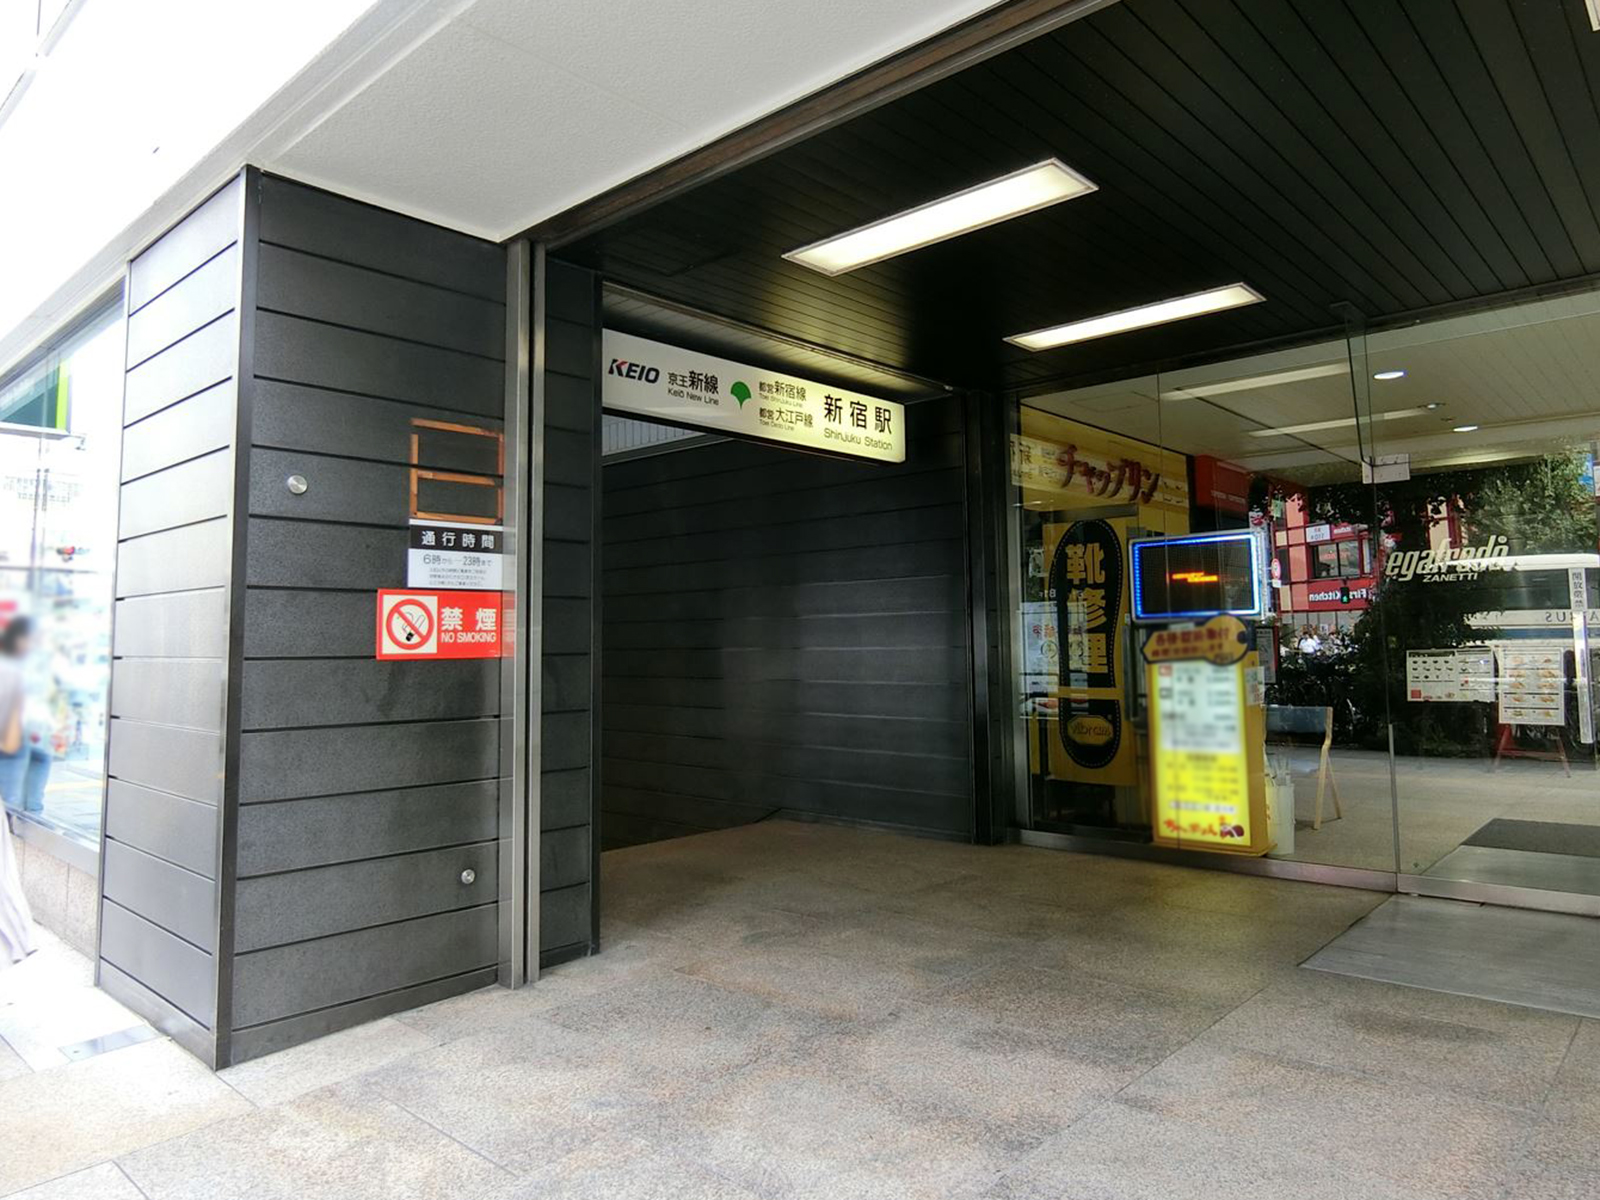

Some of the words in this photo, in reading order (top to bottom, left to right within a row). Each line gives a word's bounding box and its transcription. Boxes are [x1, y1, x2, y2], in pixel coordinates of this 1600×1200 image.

[608, 358, 660, 384] KEIO
[667, 370, 719, 395] 京王新線
[686, 392, 702, 402] New
[703, 396, 719, 405] Line
[824, 394, 892, 435] 新宿駅
[824, 427, 862, 445] Shinjuku
[864, 436, 893, 451] Station
[421, 530, 495, 549] 通行時間
[1422, 572, 1478, 582] ZANETTI
[441, 606, 497, 631] 禁煙
[441, 632, 455, 643] NO
[456, 632, 497, 643] SMOKING
